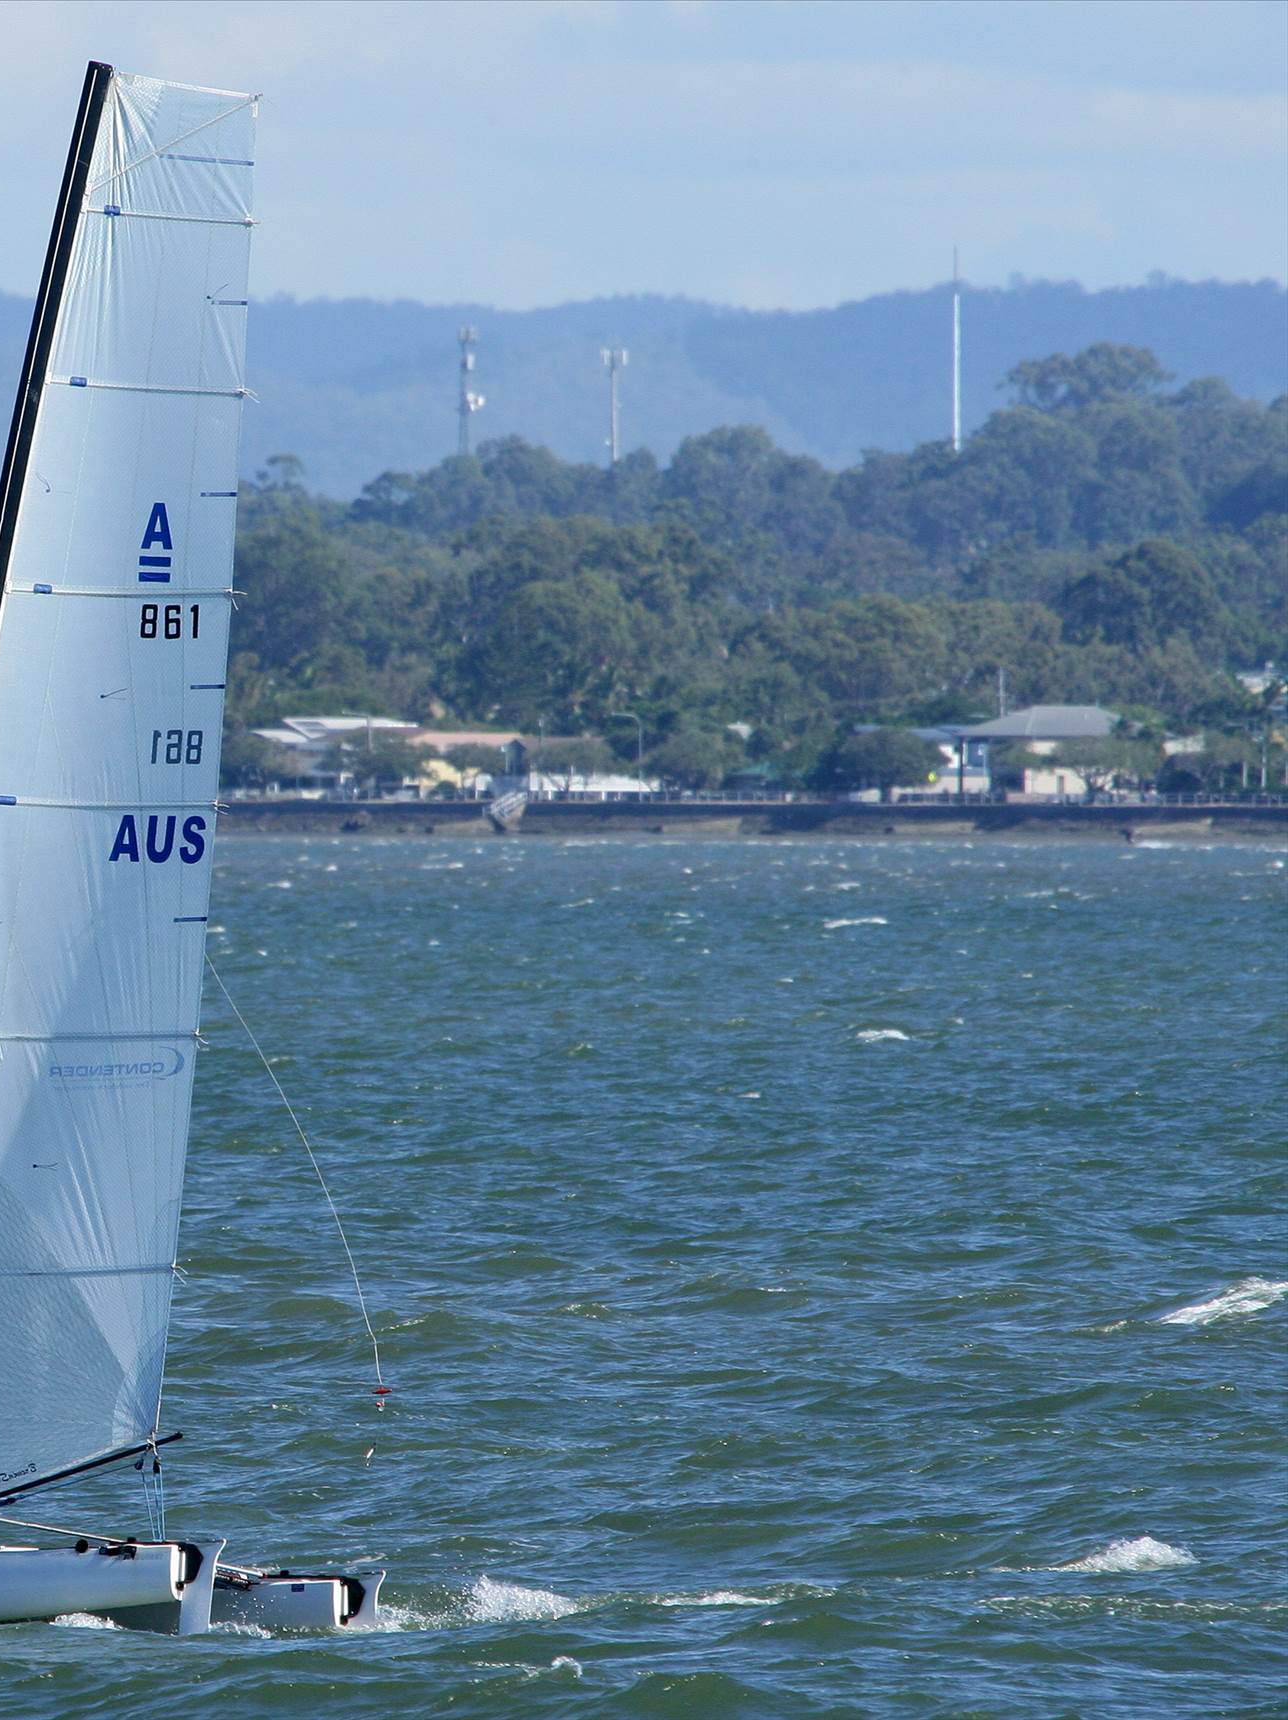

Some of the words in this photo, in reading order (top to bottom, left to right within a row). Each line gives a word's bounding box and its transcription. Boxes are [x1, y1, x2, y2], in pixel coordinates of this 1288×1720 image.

[141, 502, 173, 550] A
[140, 604, 200, 639] 861
[109, 814, 206, 864] AUS
